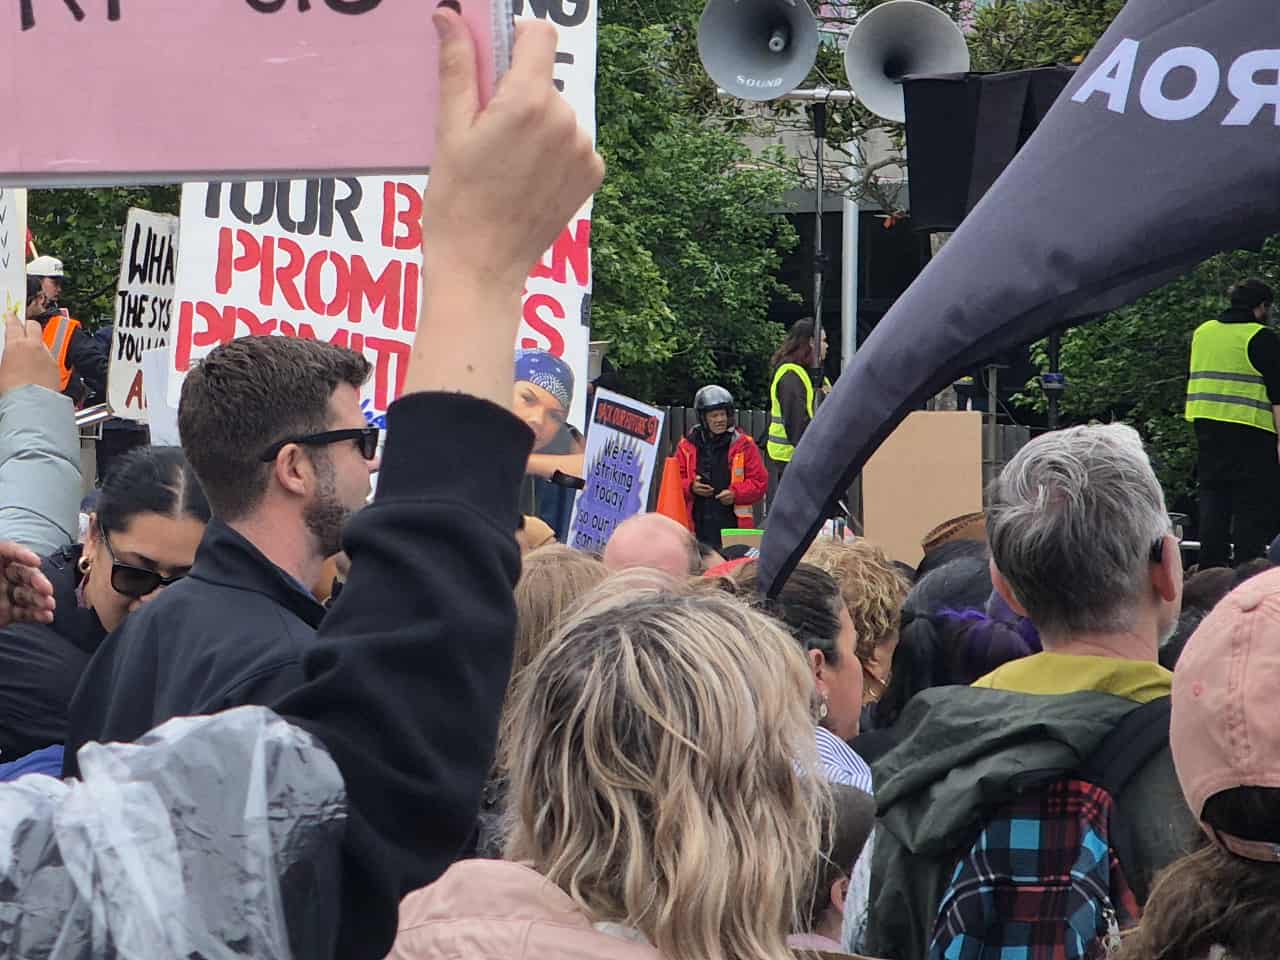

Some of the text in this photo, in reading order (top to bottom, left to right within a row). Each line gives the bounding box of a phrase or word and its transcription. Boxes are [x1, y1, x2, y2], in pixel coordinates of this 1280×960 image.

[118, 290, 149, 329] THE
[215, 226, 566, 360] PROMIS
[604, 438, 634, 466] We're
[594, 460, 634, 493] striking
[591, 514, 610, 533] our
